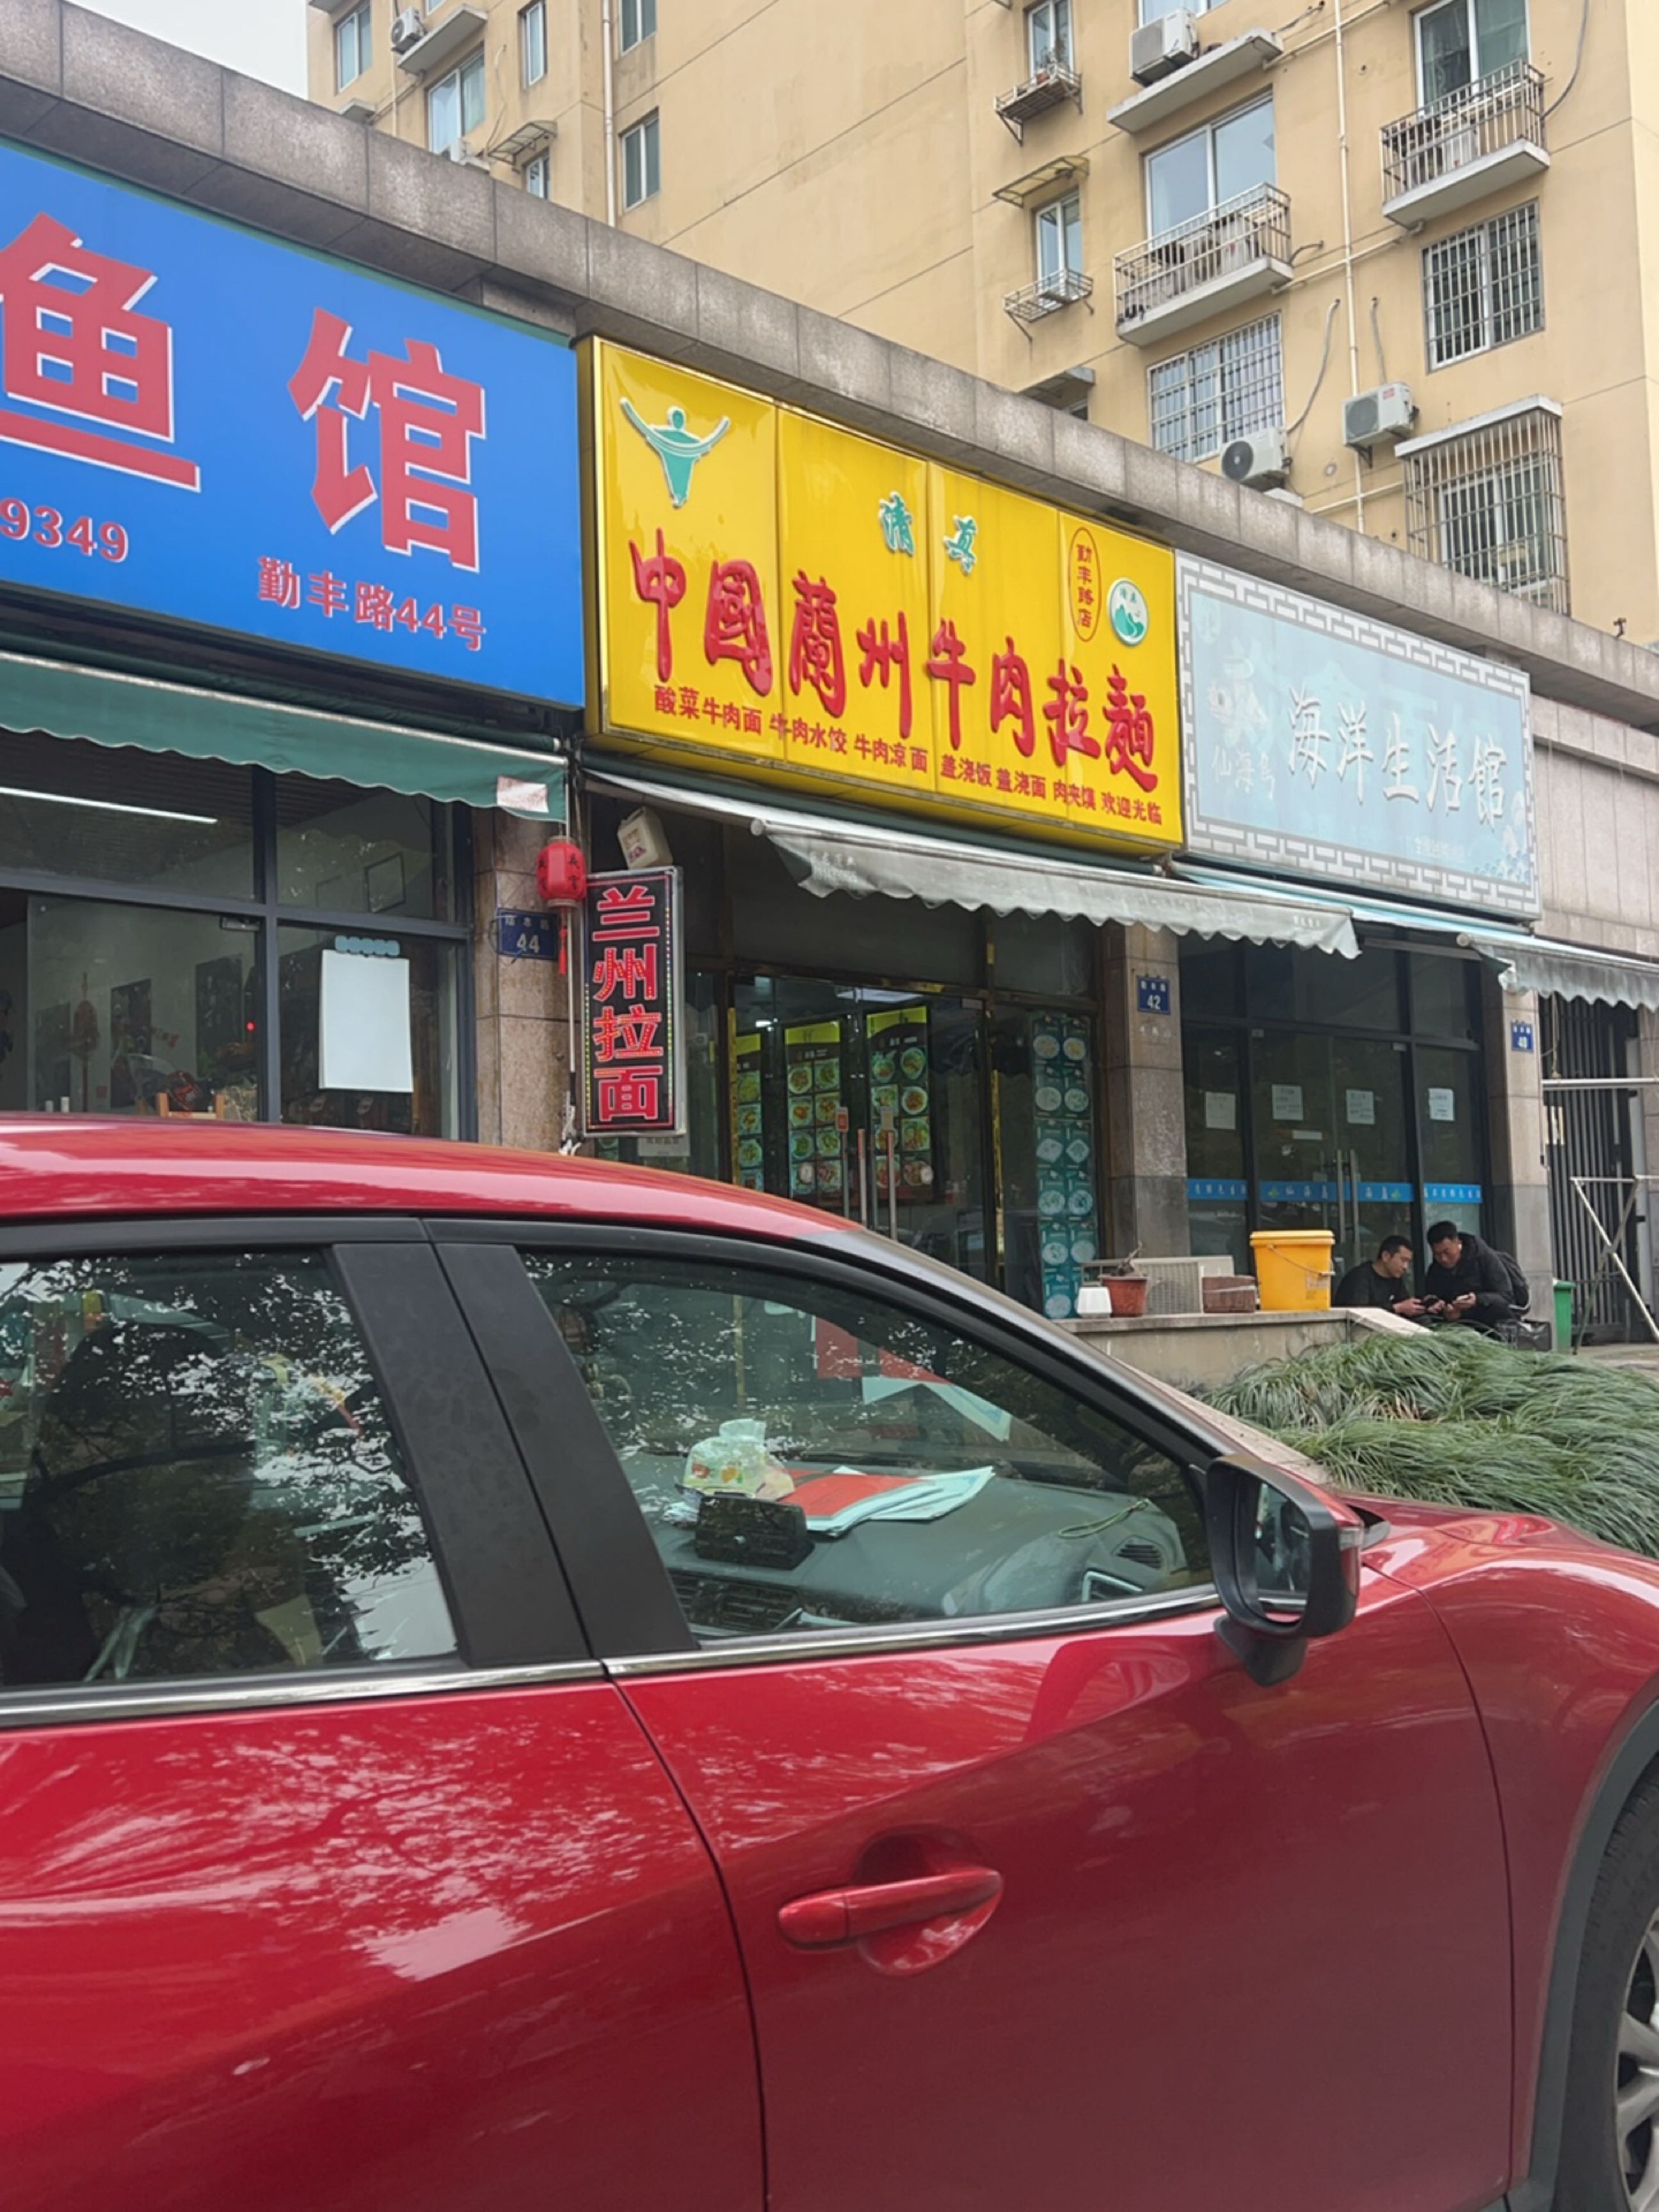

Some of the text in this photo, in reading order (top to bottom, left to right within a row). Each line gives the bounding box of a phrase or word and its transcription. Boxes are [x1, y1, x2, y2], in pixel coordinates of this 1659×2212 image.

[0, 497, 129, 563] 9349
[879, 490, 978, 576] 清真
[258, 556, 487, 652] 勤丰路44号
[654, 684, 762, 735] 酸菜牛肉面
[1101, 790, 1162, 826] 欢迎光临
[517, 932, 540, 954] 44
[593, 885, 664, 1121] 兰州拉面
